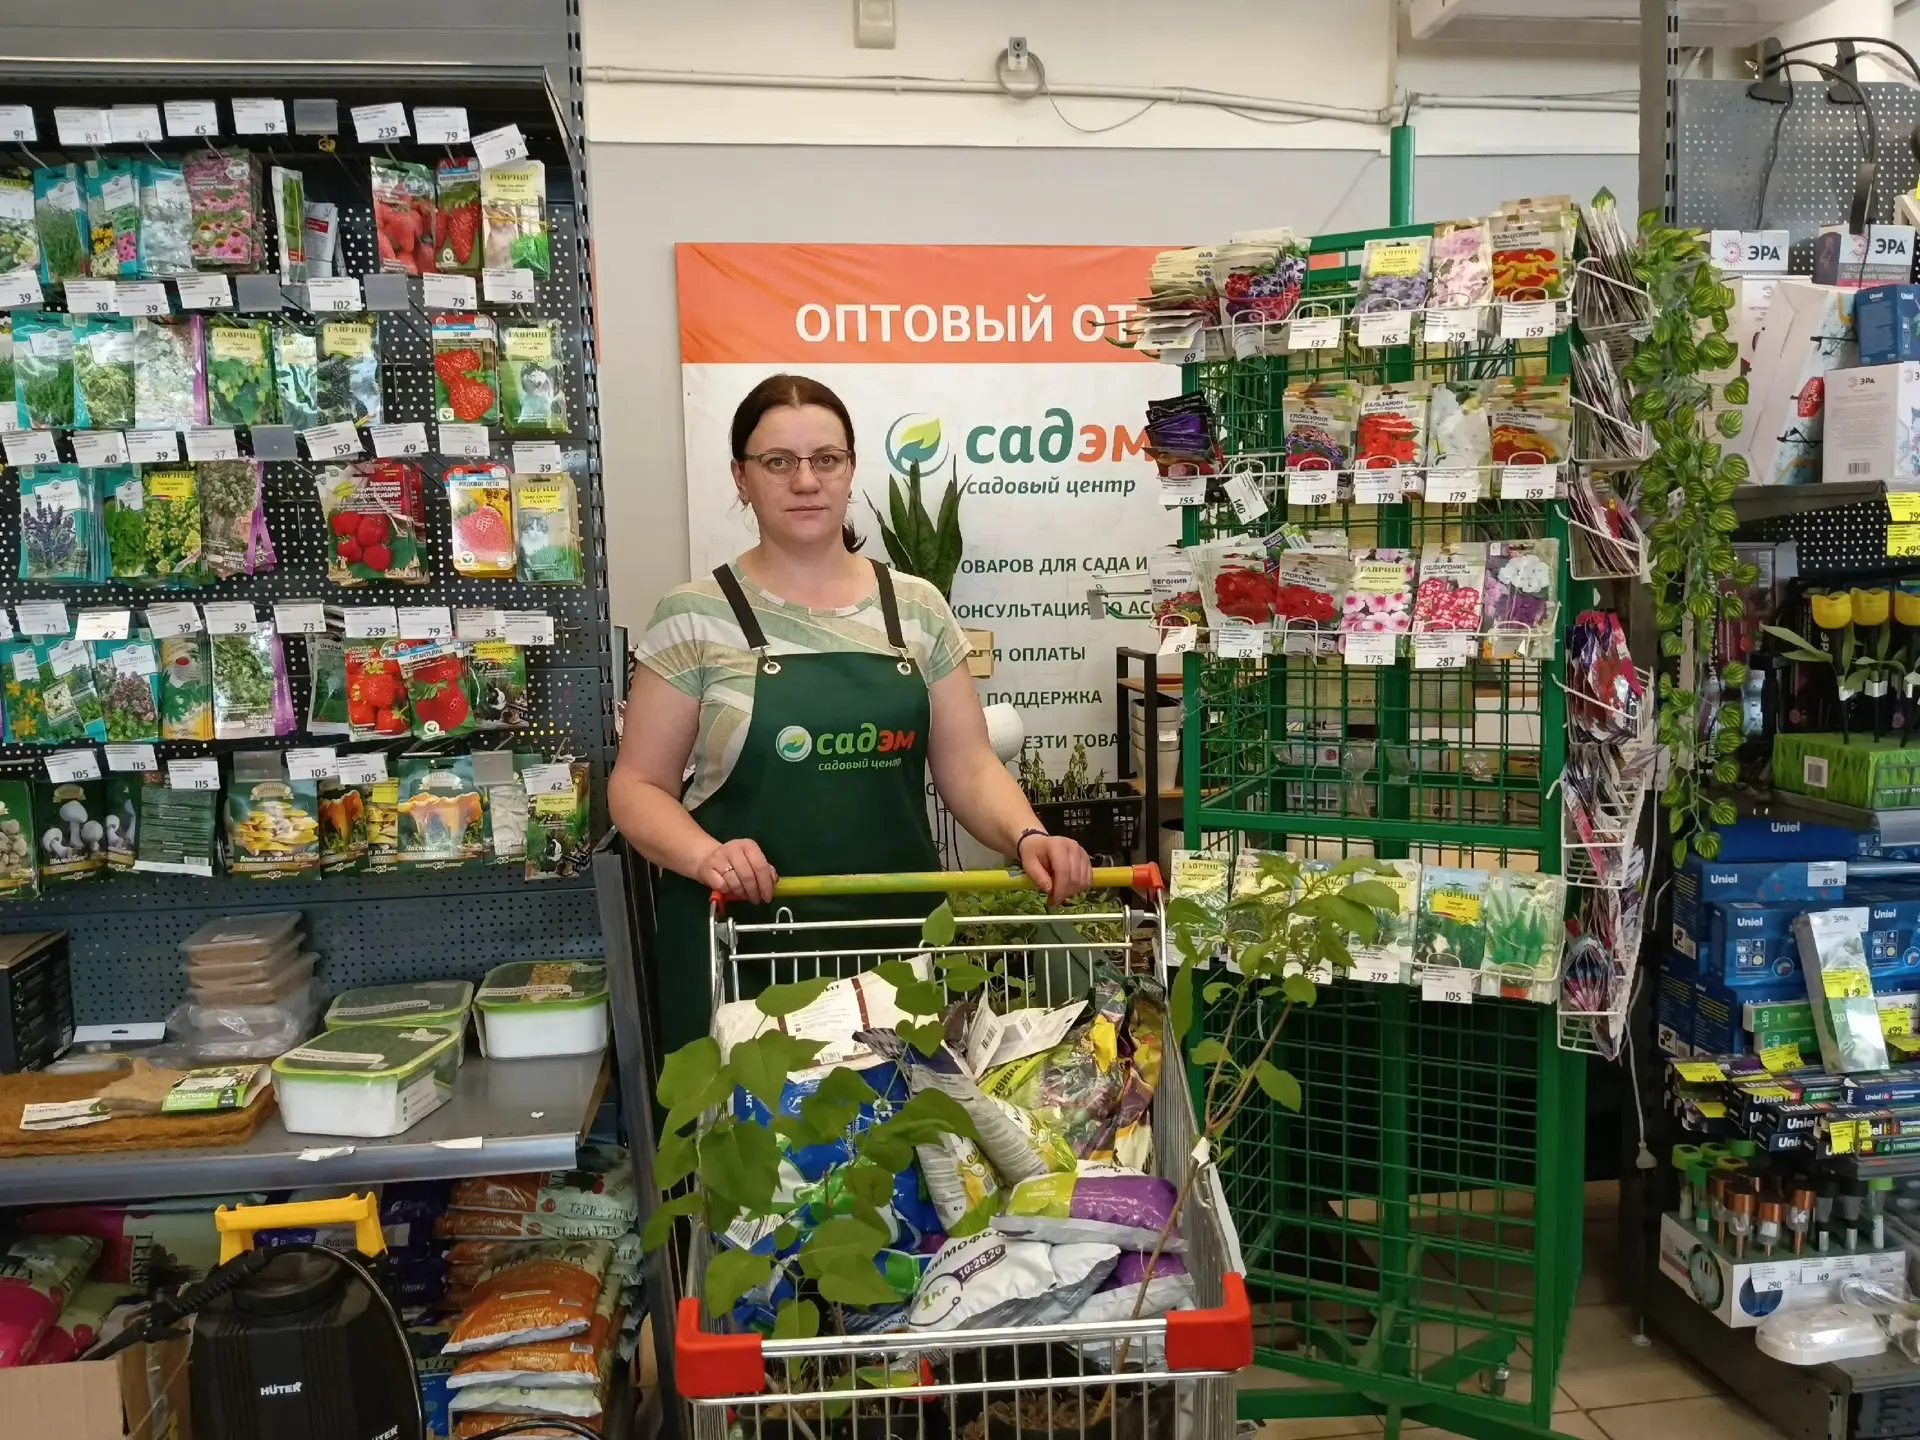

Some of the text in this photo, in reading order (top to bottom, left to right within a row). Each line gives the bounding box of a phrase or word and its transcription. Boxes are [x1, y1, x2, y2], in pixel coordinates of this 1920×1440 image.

[194, 125, 207, 135] 45
[264, 122, 276, 133] 19
[378, 126, 398, 138] 239
[13, 130, 25, 139] 91
[445, 131, 459, 142] 79
[505, 148, 517, 160] 39
[1875, 238, 1906, 255] ЭРА
[1747, 246, 1780, 261] ЭРА
[19, 293, 31, 303] 39
[510, 290, 523, 300] 36
[208, 296, 221, 306] 72
[332, 300, 350, 311] 102
[452, 298, 465, 308] 79
[96, 302, 109, 312] 30
[145, 304, 158, 314] 39
[795, 293, 1138, 343] ОПТОВЫЙ ОТ
[1525, 326, 1544, 337] 159
[1381, 334, 1398, 344] 165
[1447, 332, 1466, 342] 219
[1310, 339, 1326, 348] 137
[1184, 353, 1196, 363] 69
[1859, 377, 1875, 385] ЭРА
[333, 443, 351, 455] 159
[403, 444, 417, 454] 49
[464, 446, 478, 455] 64
[34, 453, 47, 463] 39
[104, 454, 117, 464] 40
[156, 451, 169, 461] 39
[539, 464, 552, 473] 39
[966, 475, 1136, 498] садовый центр
[1377, 493, 1395, 503] 179
[1449, 491, 1467, 501] 179
[1525, 488, 1543, 499] 159
[1310, 494, 1327, 504] 189
[1233, 498, 1246, 515] 140
[1039, 556, 1077, 576] ДЛЯ
[1082, 556, 1130, 574] САДА
[1136, 556, 1148, 571] И
[178, 623, 191, 633] 39
[234, 623, 247, 632] 39
[303, 623, 315, 632] 73
[366, 627, 386, 636] 239
[427, 628, 440, 637] 79
[102, 630, 116, 639] 42
[484, 628, 497, 638] 35
[531, 635, 544, 645] 39
[1174, 643, 1187, 653] 89
[1009, 646, 1087, 663] ОПЛАТЫ
[1238, 649, 1253, 658] 132
[1364, 654, 1383, 664] 175
[1436, 657, 1455, 667] 287
[986, 689, 1103, 708] ПОДДЕРЖКА
[1021, 733, 1121, 750] ЕЗТИ ТОВА
[131, 761, 146, 770] 115
[817, 756, 902, 773] садовый центр
[72, 769, 89, 779] 105
[310, 768, 328, 778] 105
[361, 773, 377, 783] 105
[195, 780, 209, 789] 115
[551, 782, 563, 790] 42
[1770, 821, 1801, 833] Uniel
[1710, 873, 1738, 884] Uniel
[1874, 908, 1897, 919] Uniel
[1737, 916, 1763, 927] Uniel
[1369, 972, 1388, 981] 379
[1444, 991, 1462, 1001] 105
[1834, 1013, 1846, 1023] 20
[1887, 1026, 1902, 1035] 499
[1865, 1092, 1882, 1102] Uniel
[1779, 1101, 1811, 1113] Uniel
[1787, 1115, 1818, 1131] Uniel
[1779, 1136, 1801, 1149] Uni
[1817, 1273, 1829, 1282] 149
[1767, 1281, 1782, 1290] 290
[260, 1381, 302, 1396] HÜTER
